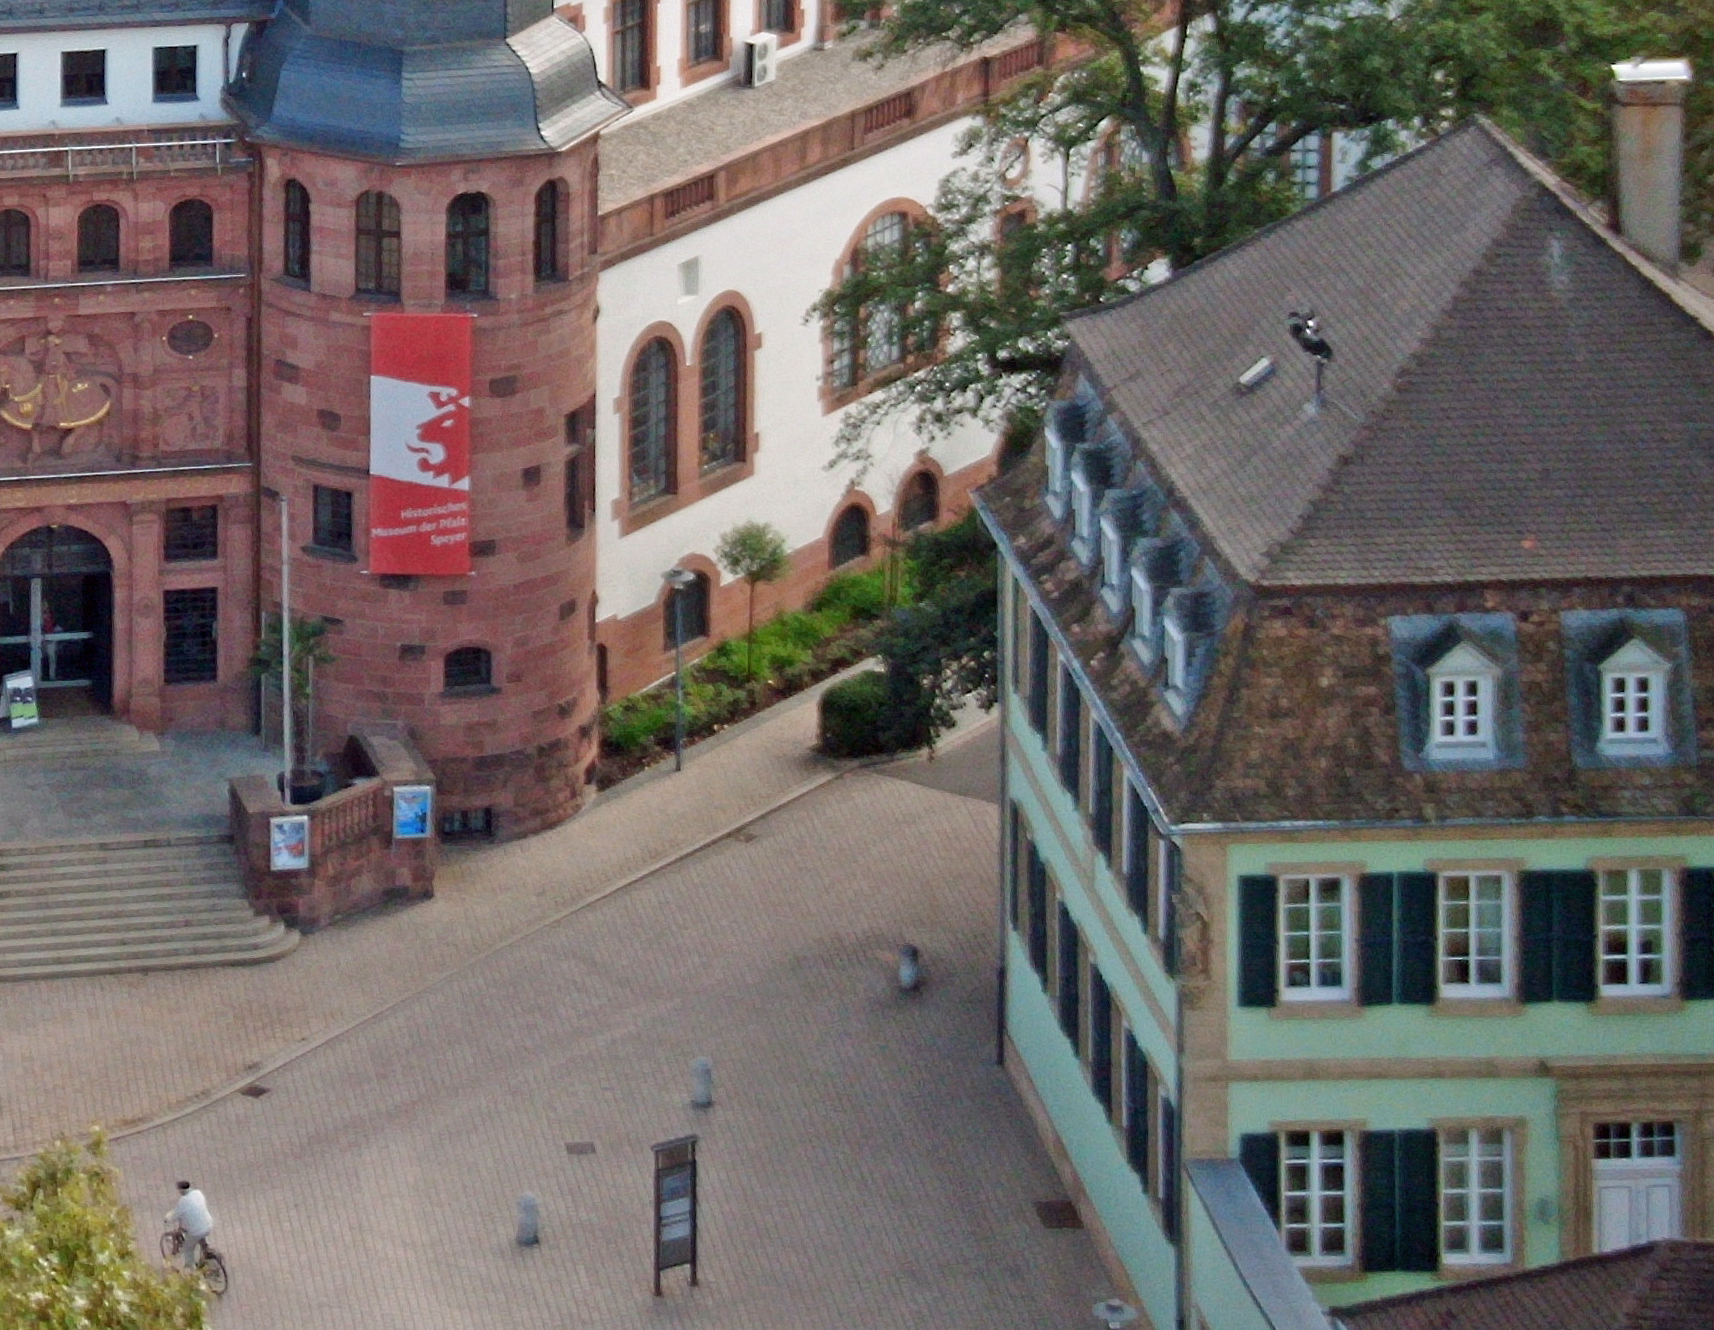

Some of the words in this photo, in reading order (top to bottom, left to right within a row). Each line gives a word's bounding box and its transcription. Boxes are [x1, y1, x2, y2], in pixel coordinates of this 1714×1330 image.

[401, 502, 466, 519] Historisches
[370, 525, 417, 539] Museum
[419, 521, 437, 533] der
[439, 517, 466, 529] Pfalz
[431, 533, 466, 546] Speyer
